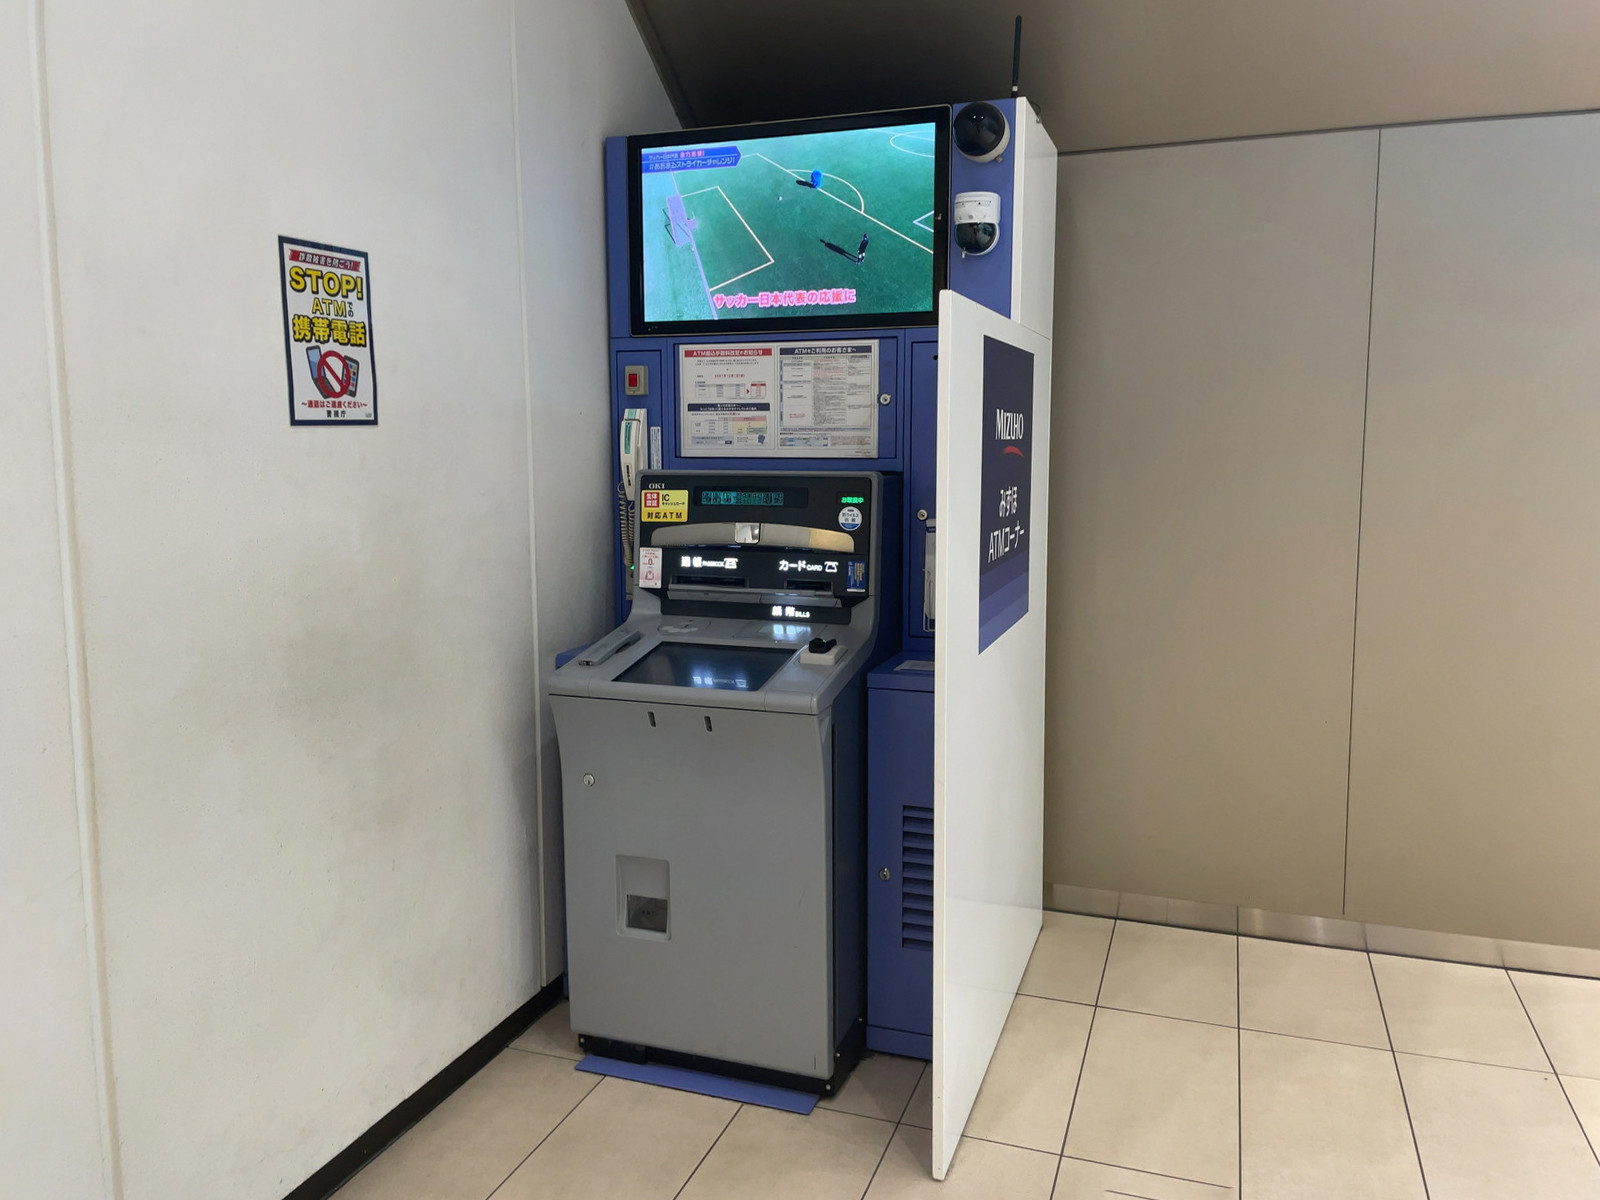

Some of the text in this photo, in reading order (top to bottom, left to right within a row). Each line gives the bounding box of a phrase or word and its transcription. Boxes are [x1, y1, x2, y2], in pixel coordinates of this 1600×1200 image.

[289, 265, 364, 300] STOP!
[713, 288, 857, 309] サッカー日本代表の応援に
[292, 315, 367, 347] 携帯電話
[995, 408, 1024, 441] MIZUHO
[648, 482, 665, 490] OKI
[661, 493, 670, 502] IC
[998, 486, 1018, 518] みずほ
[987, 520, 1025, 563] ATMコーナー
[778, 559, 823, 572] カード CARD
